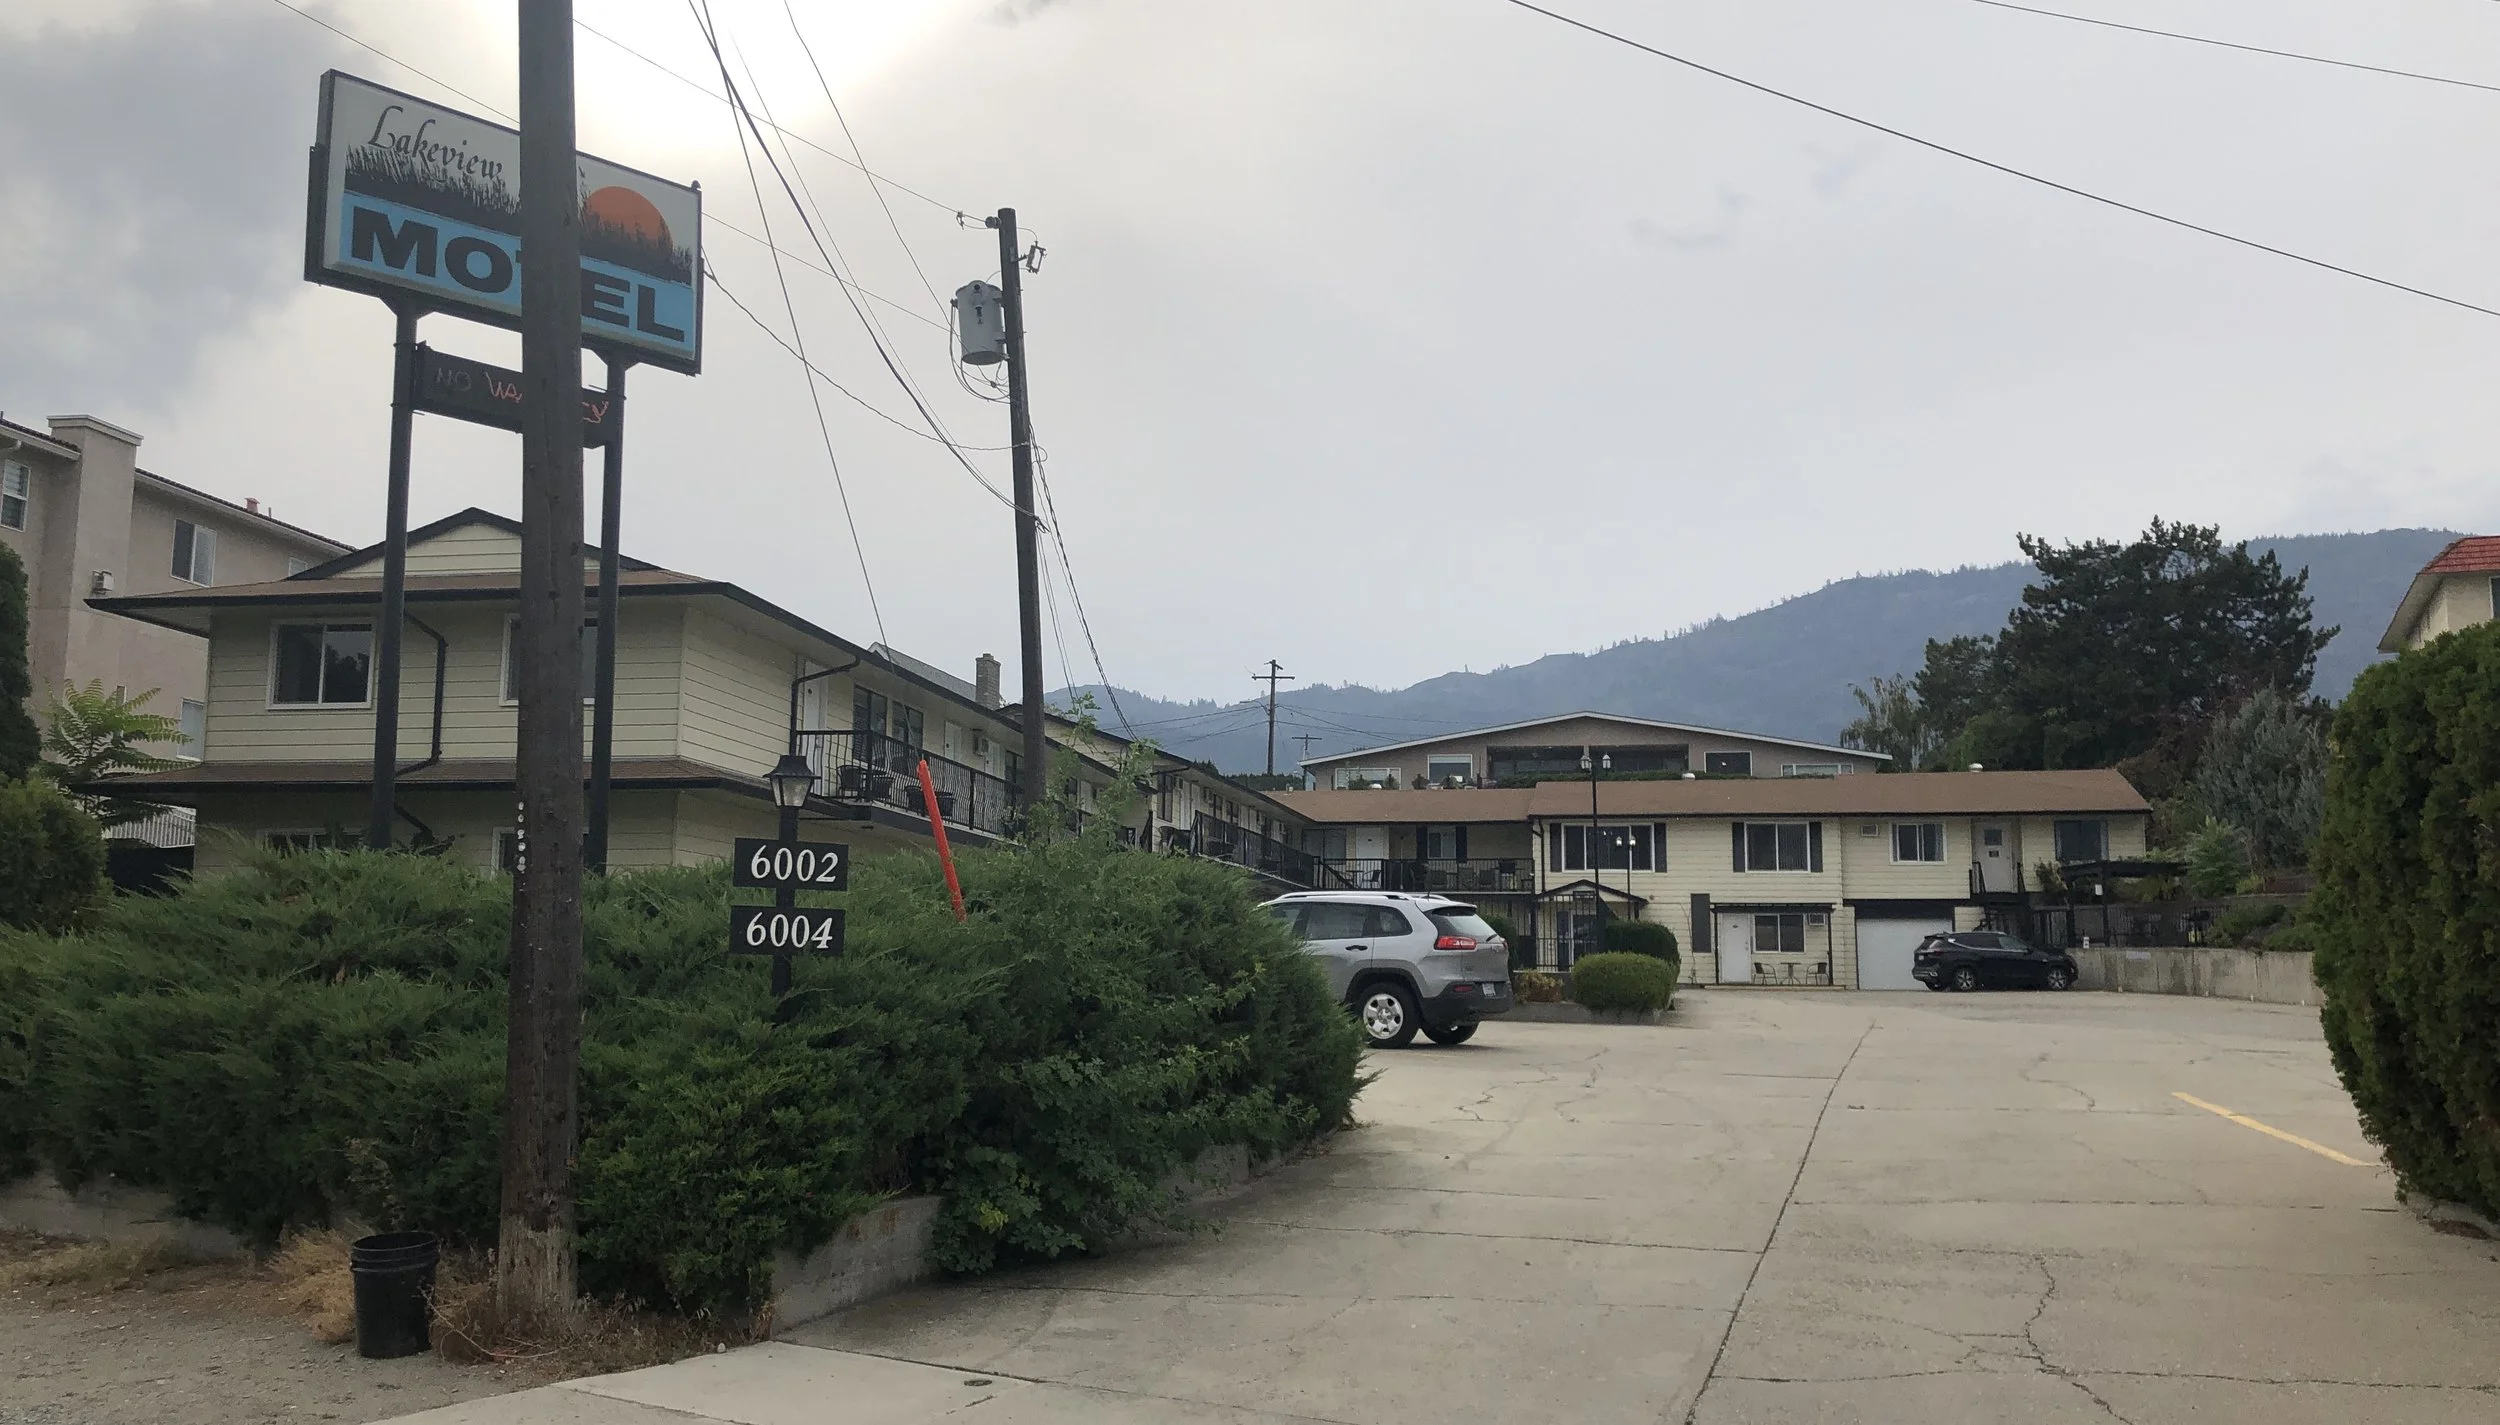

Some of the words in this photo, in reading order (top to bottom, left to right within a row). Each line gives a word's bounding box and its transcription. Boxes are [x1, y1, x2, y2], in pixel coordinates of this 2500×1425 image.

[368, 105, 503, 178] Lakeview
[351, 205, 685, 342] MOEL
[434, 367, 472, 392] NO
[751, 845, 839, 883] 6002
[746, 912, 833, 949] 6004
